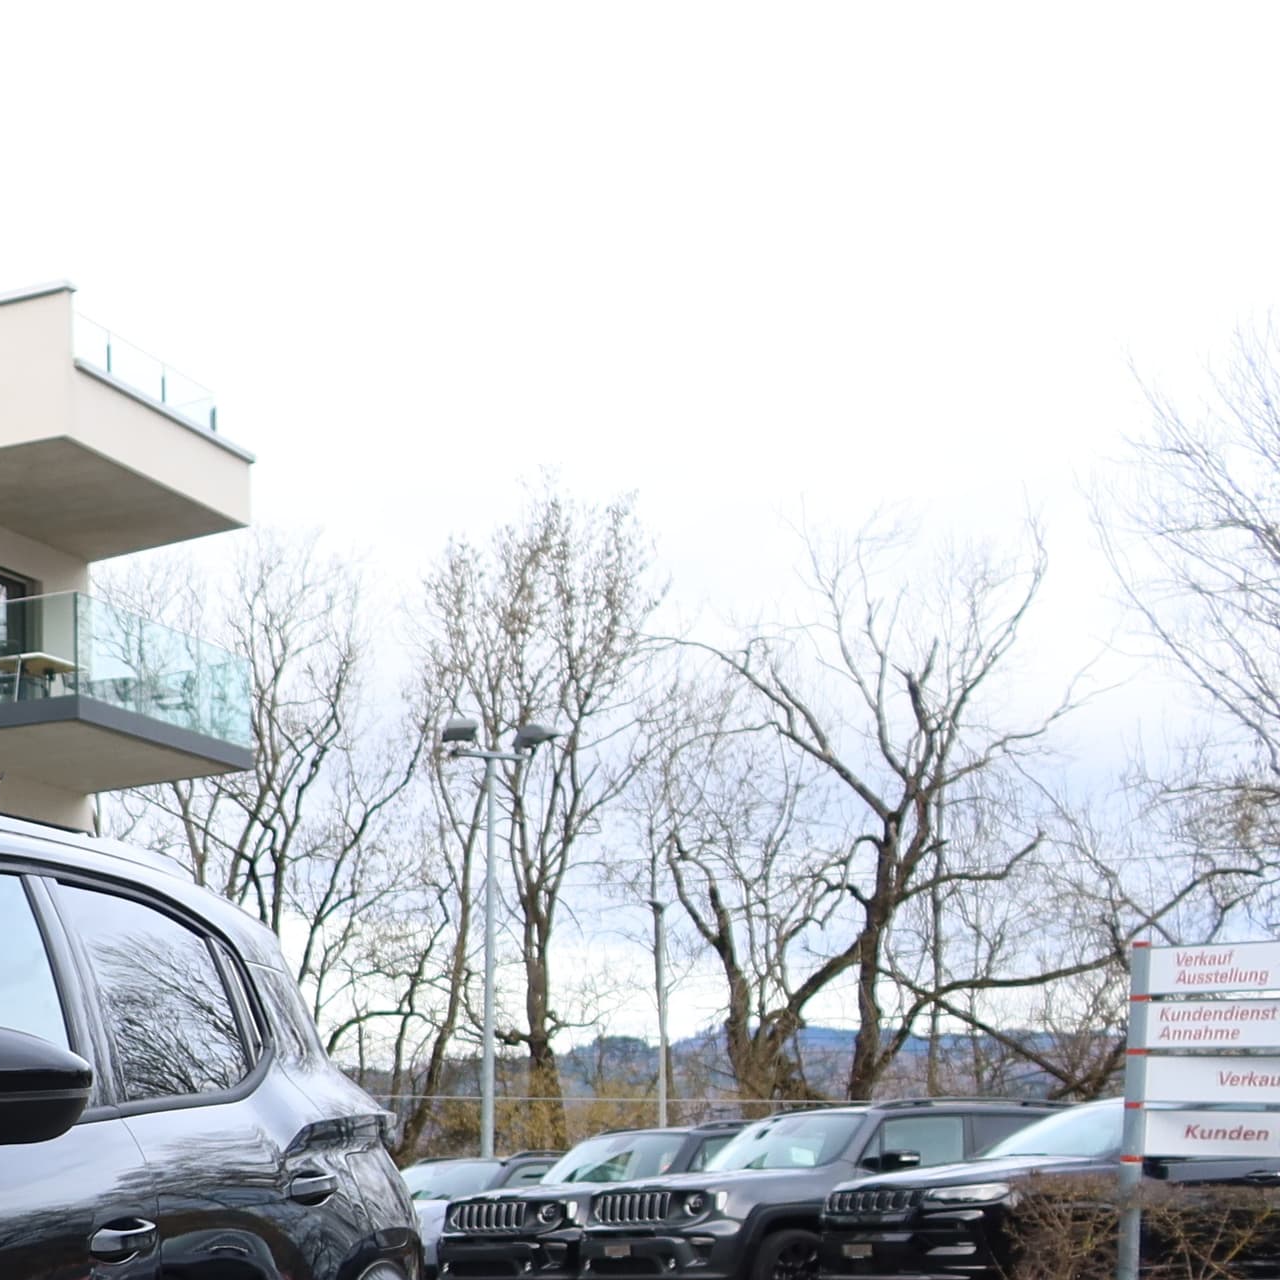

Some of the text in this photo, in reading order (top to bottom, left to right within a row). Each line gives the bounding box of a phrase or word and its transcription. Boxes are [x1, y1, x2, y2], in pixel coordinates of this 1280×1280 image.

[1176, 949, 1235, 967] Verkauf
[1175, 967, 1270, 986] Ausstellung
[1158, 1005, 1279, 1023] Kundendienst
[1158, 1026, 1241, 1041] Annahme
[1184, 1123, 1270, 1142] Kunden
